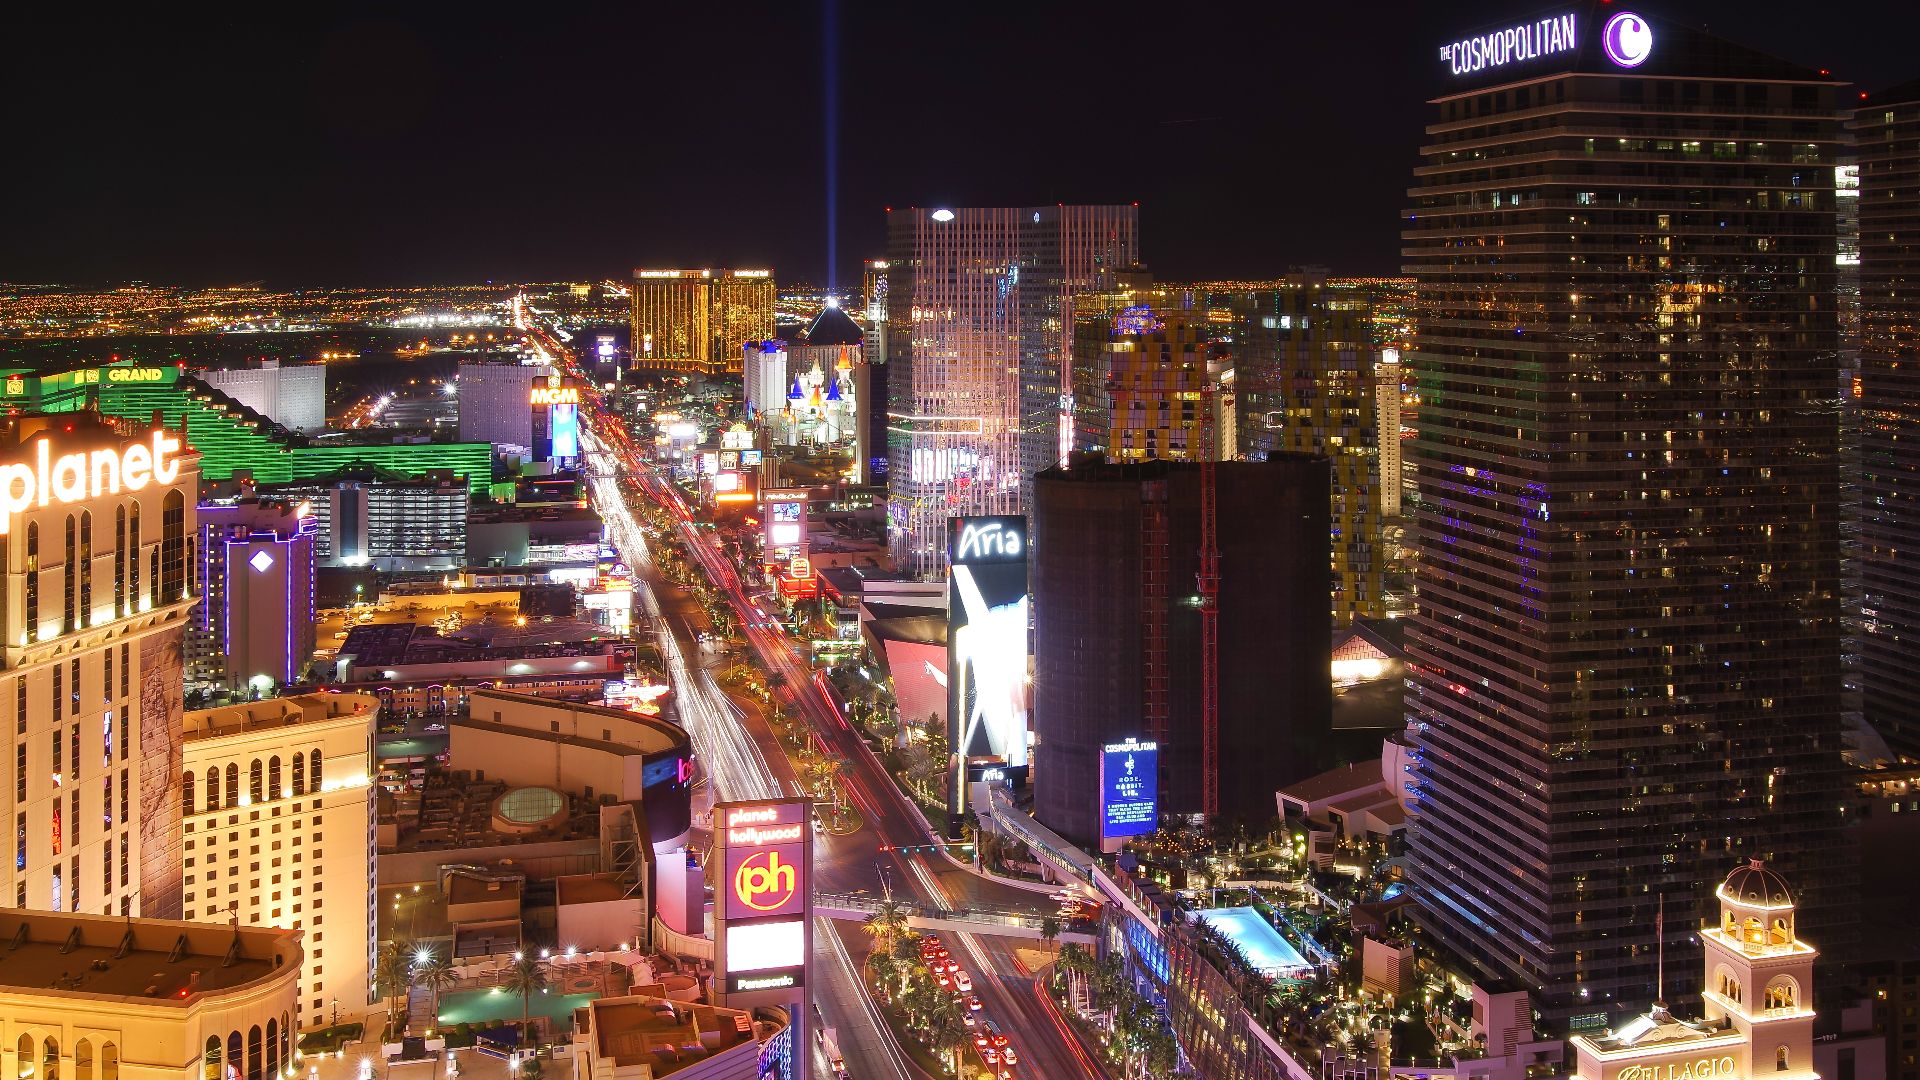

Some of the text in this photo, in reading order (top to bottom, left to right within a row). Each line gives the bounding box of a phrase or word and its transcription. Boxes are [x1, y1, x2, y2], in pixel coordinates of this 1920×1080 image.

[1439, 13, 1576, 75] THE COSMOPOLITAN
[108, 368, 163, 382] GRAND
[530, 387, 578, 404] MGM
[0, 430, 181, 536] planet
[958, 523, 1020, 559] Aria
[1105, 742, 1157, 753] COSMOPOLITAN
[981, 768, 1004, 782] Aria
[729, 808, 777, 827] planet
[729, 825, 801, 845] hollywood
[742, 851, 795, 906] ph
[737, 974, 794, 991] Panasonic
[1617, 1056, 1735, 1080] BELLAGIO
